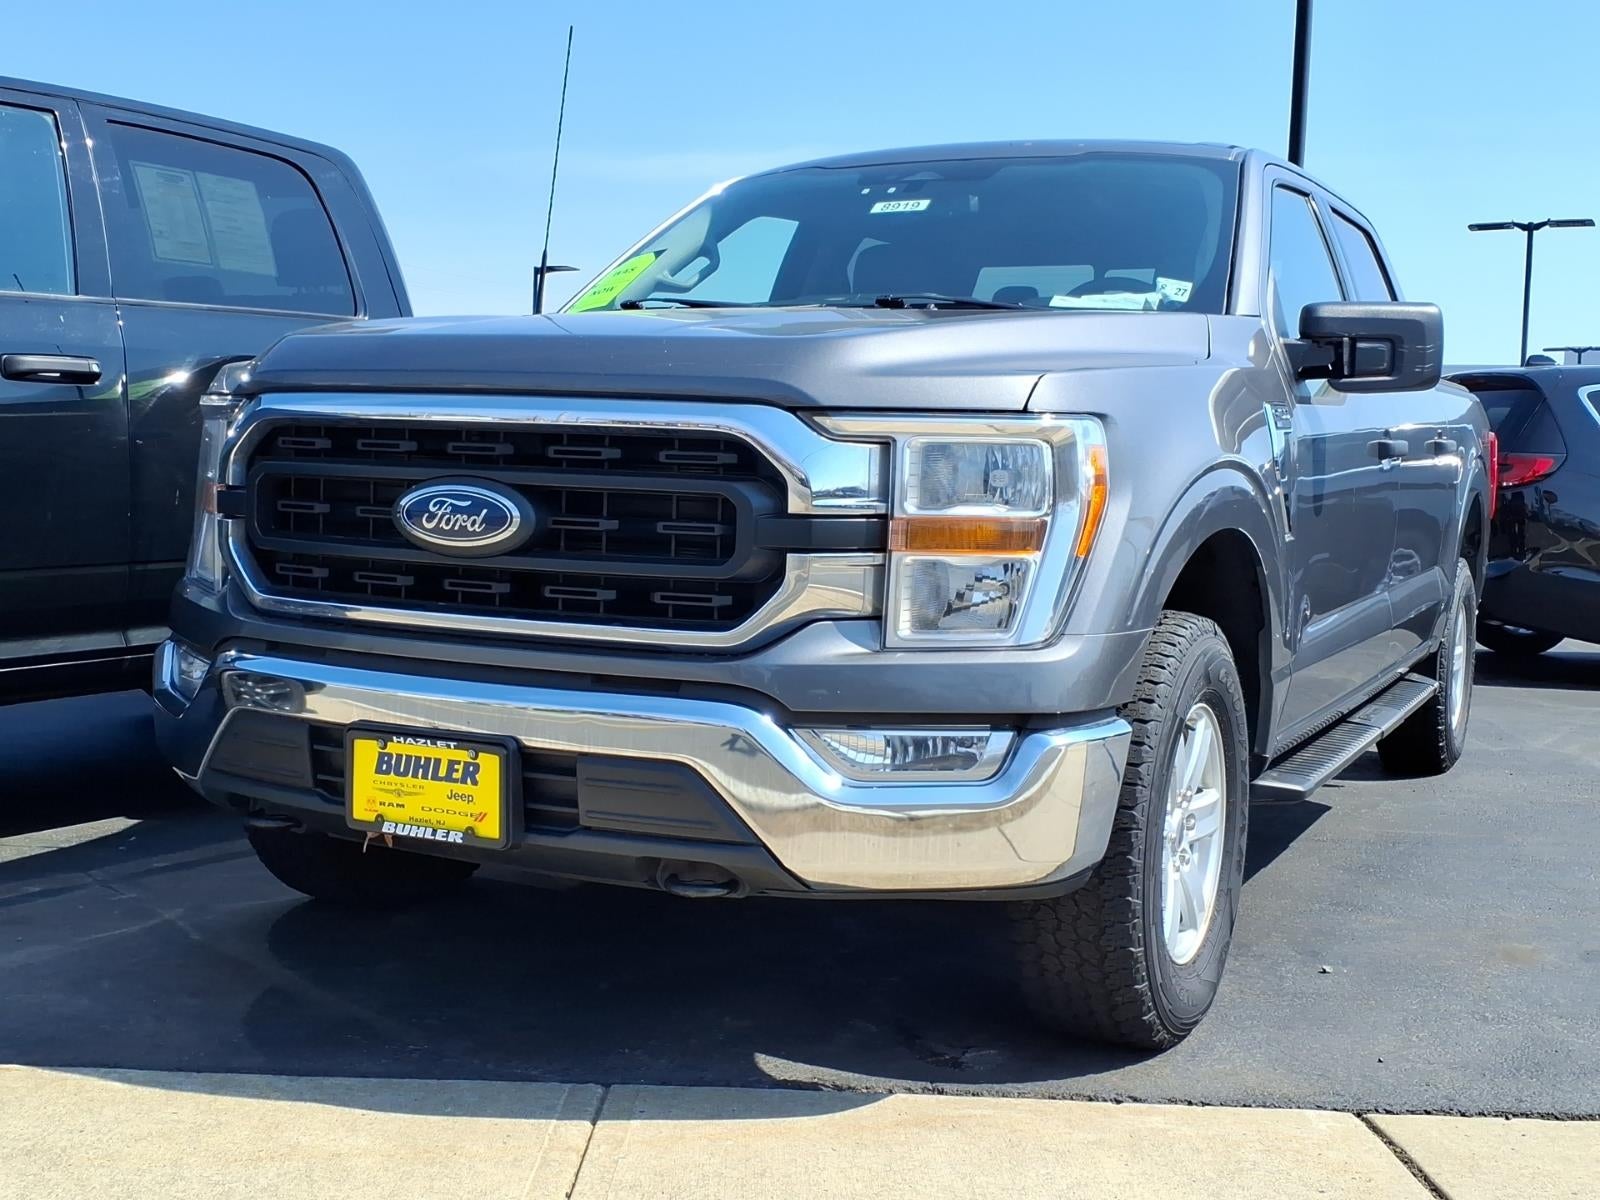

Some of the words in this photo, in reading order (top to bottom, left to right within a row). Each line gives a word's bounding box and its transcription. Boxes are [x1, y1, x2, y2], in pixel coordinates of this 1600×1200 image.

[881, 202, 921, 211] 8919
[1174, 288, 1188, 297] 27
[422, 497, 488, 532] Ford
[392, 735, 458, 749] HAZLET
[374, 751, 481, 787] BUHLER
[372, 779, 425, 790] CHRYSLER
[447, 789, 475, 805] Jeep
[379, 801, 405, 809] RAM
[421, 806, 479, 818] DODGE
[381, 821, 464, 844] BUHLER
